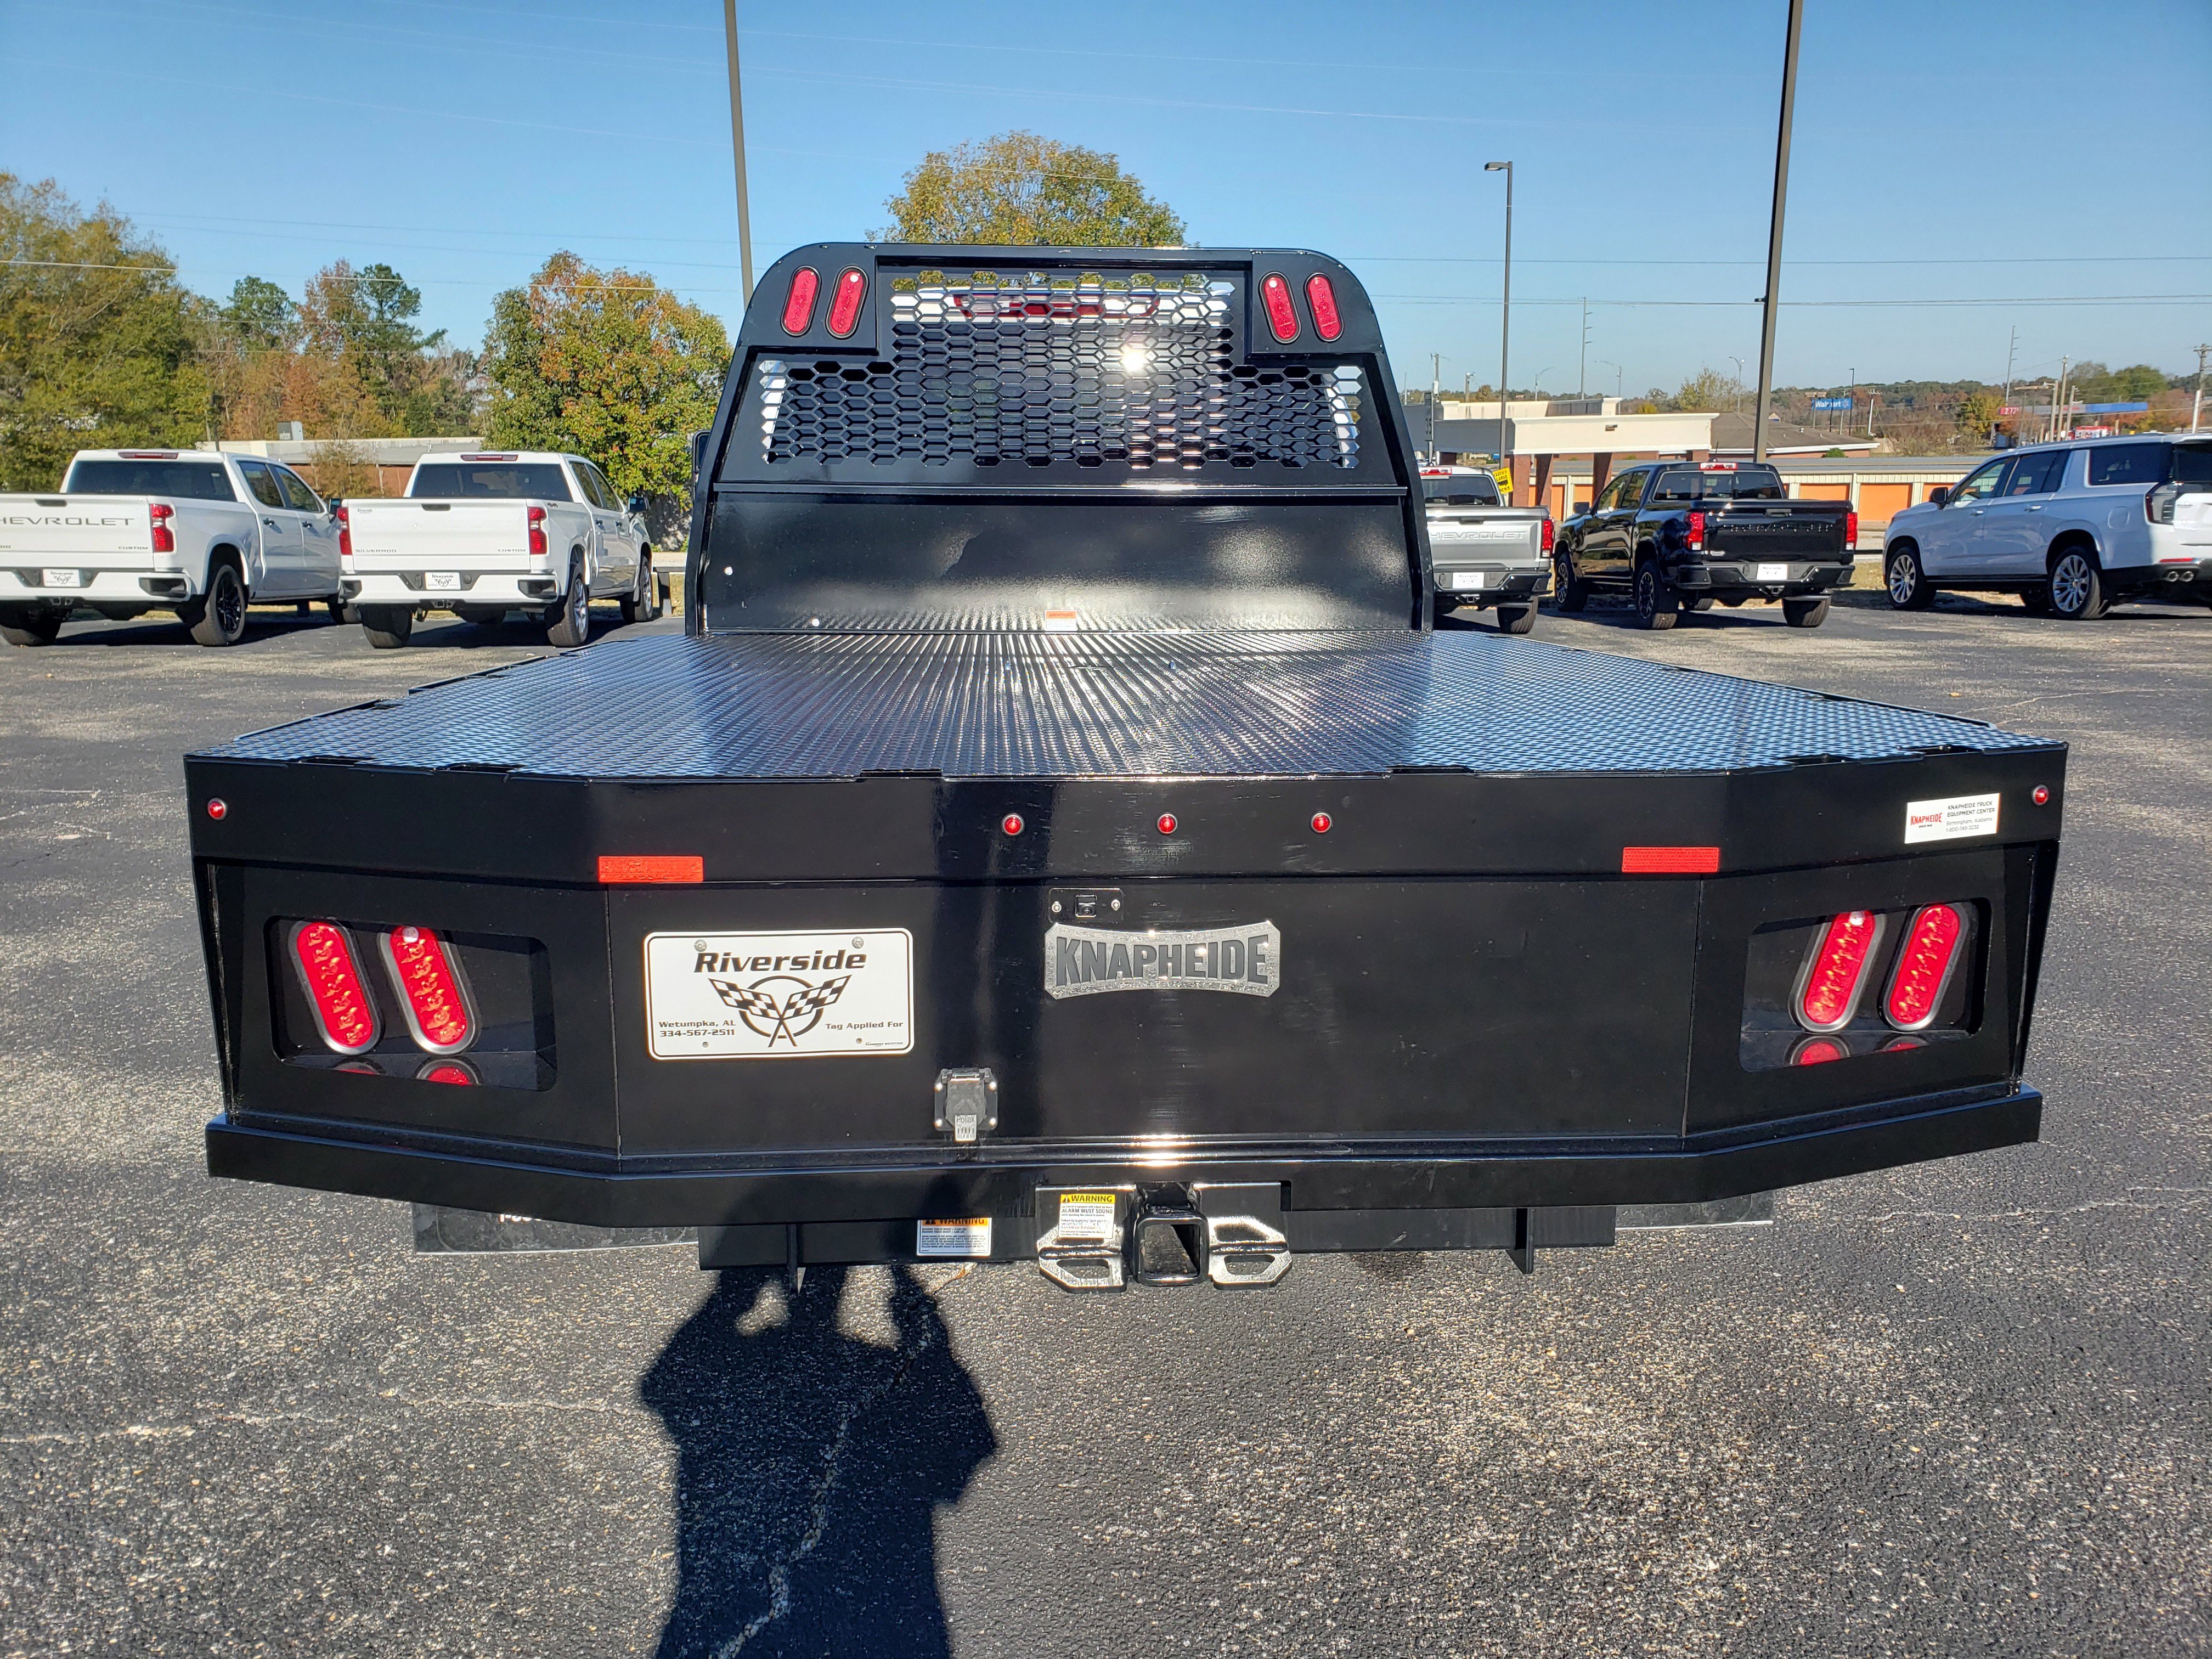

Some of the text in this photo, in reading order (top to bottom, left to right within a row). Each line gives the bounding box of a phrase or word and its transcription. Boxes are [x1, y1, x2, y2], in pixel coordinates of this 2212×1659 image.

[0, 517, 134, 526] HEVROLET
[1430, 531, 1528, 540] HEVROLET
[1910, 812, 1943, 826] KNAPHEIDE
[693, 949, 867, 973] Riverside
[1056, 934, 1269, 987] KNAPHEIDE
[847, 1022, 884, 1030] Applied
[659, 1029, 735, 1037] 334-567-2511
